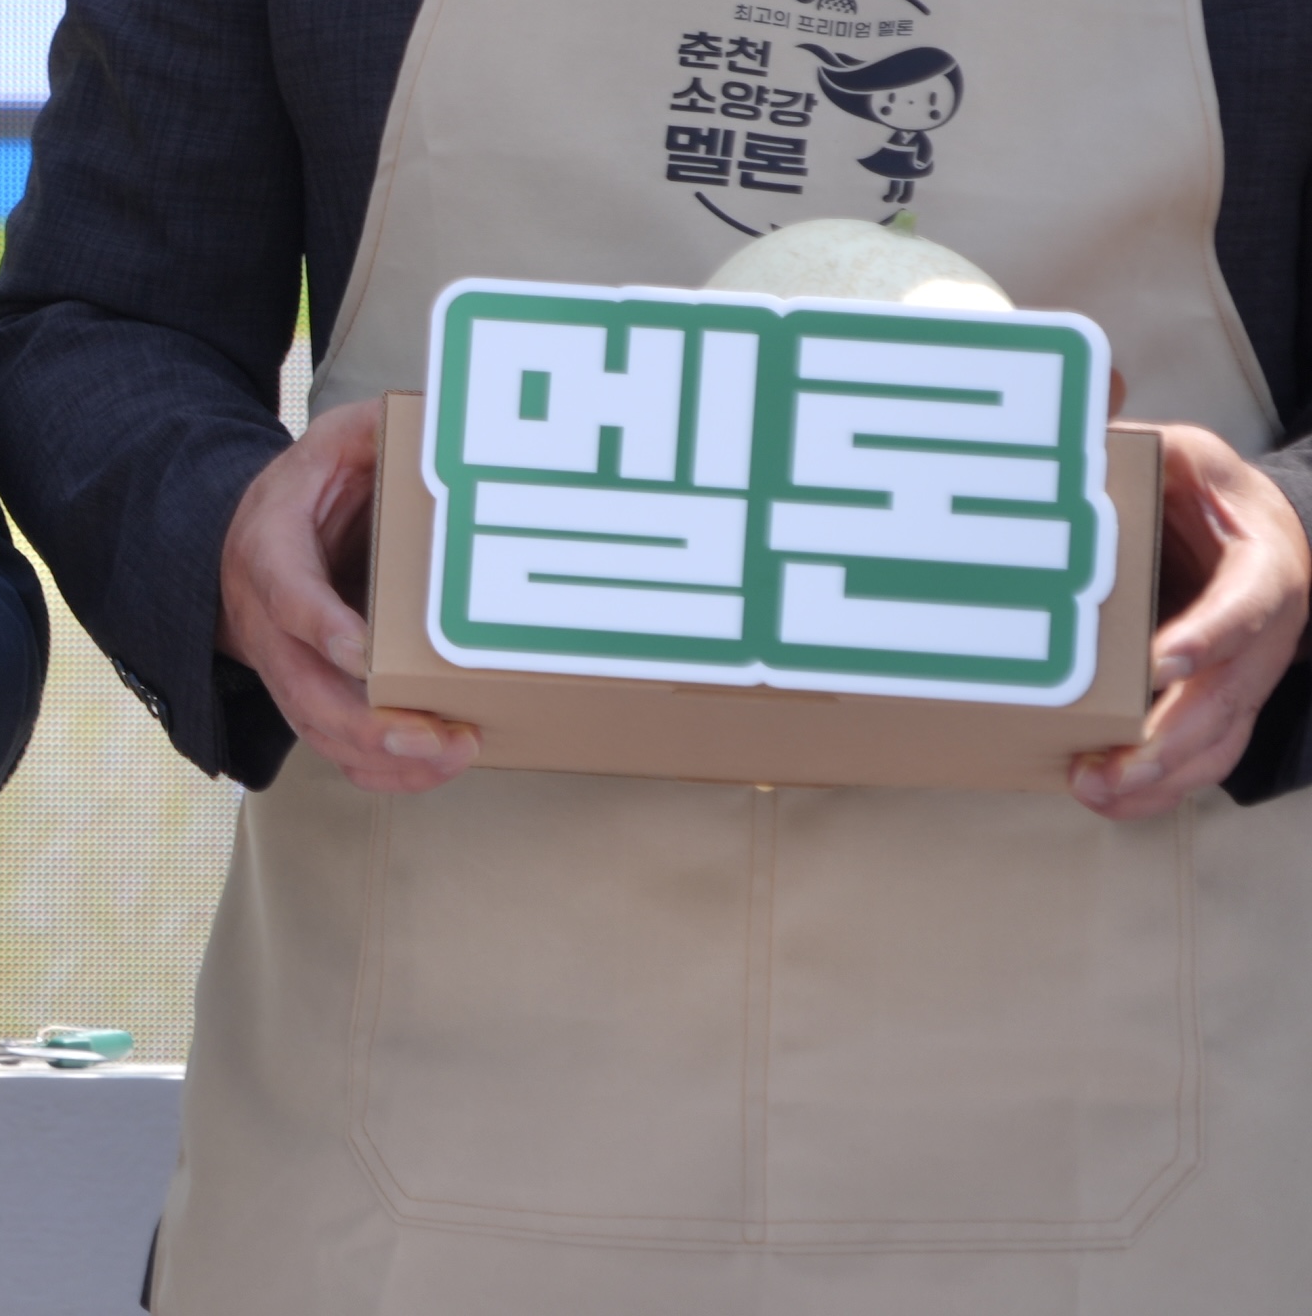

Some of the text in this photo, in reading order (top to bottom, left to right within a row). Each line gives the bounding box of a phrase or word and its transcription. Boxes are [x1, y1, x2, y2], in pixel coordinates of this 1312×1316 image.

[733, 3, 914, 39] 최고의 프리미엄 멜론
[678, 31, 772, 77] 춘천
[669, 77, 818, 127] 소양강
[665, 125, 808, 194] 멜론
[463, 318, 1071, 662] 멜론
